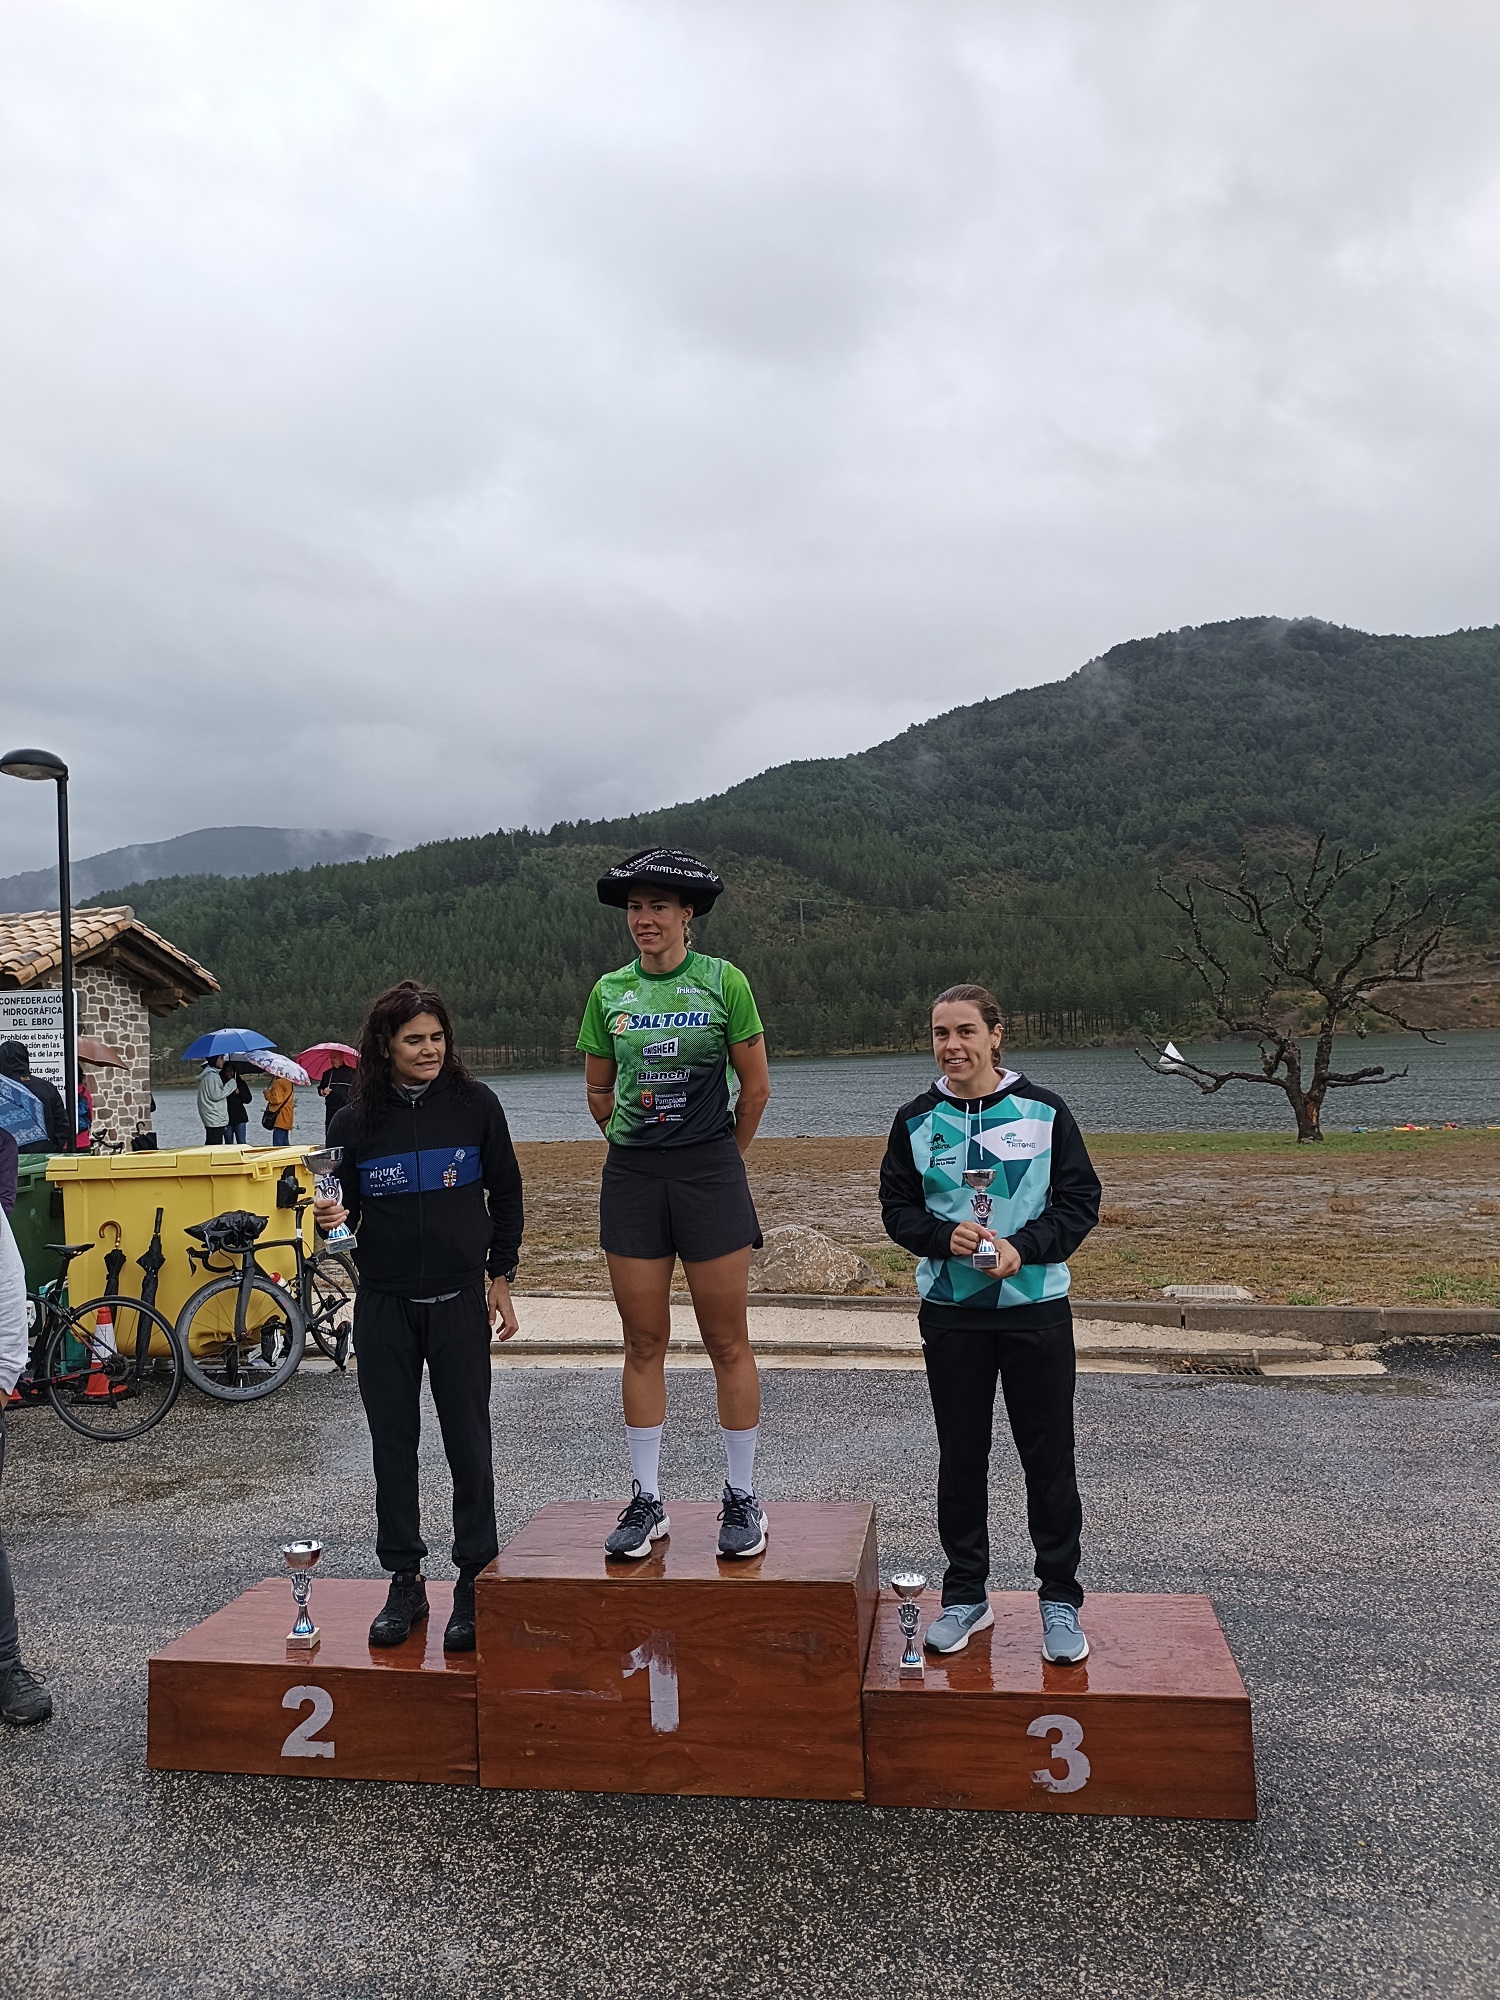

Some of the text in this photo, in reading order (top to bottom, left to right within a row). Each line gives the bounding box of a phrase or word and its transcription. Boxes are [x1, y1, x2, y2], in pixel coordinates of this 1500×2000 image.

[2, 1006, 63, 1016] HIDROGRÁFICA
[628, 1012, 710, 1030] SALTOKI
[44, 1067, 60, 1075] dago
[638, 1069, 690, 1080] Bianchi
[621, 1630, 680, 1733] 1
[281, 1686, 336, 1759] 2
[1026, 1714, 1091, 1794] 3
